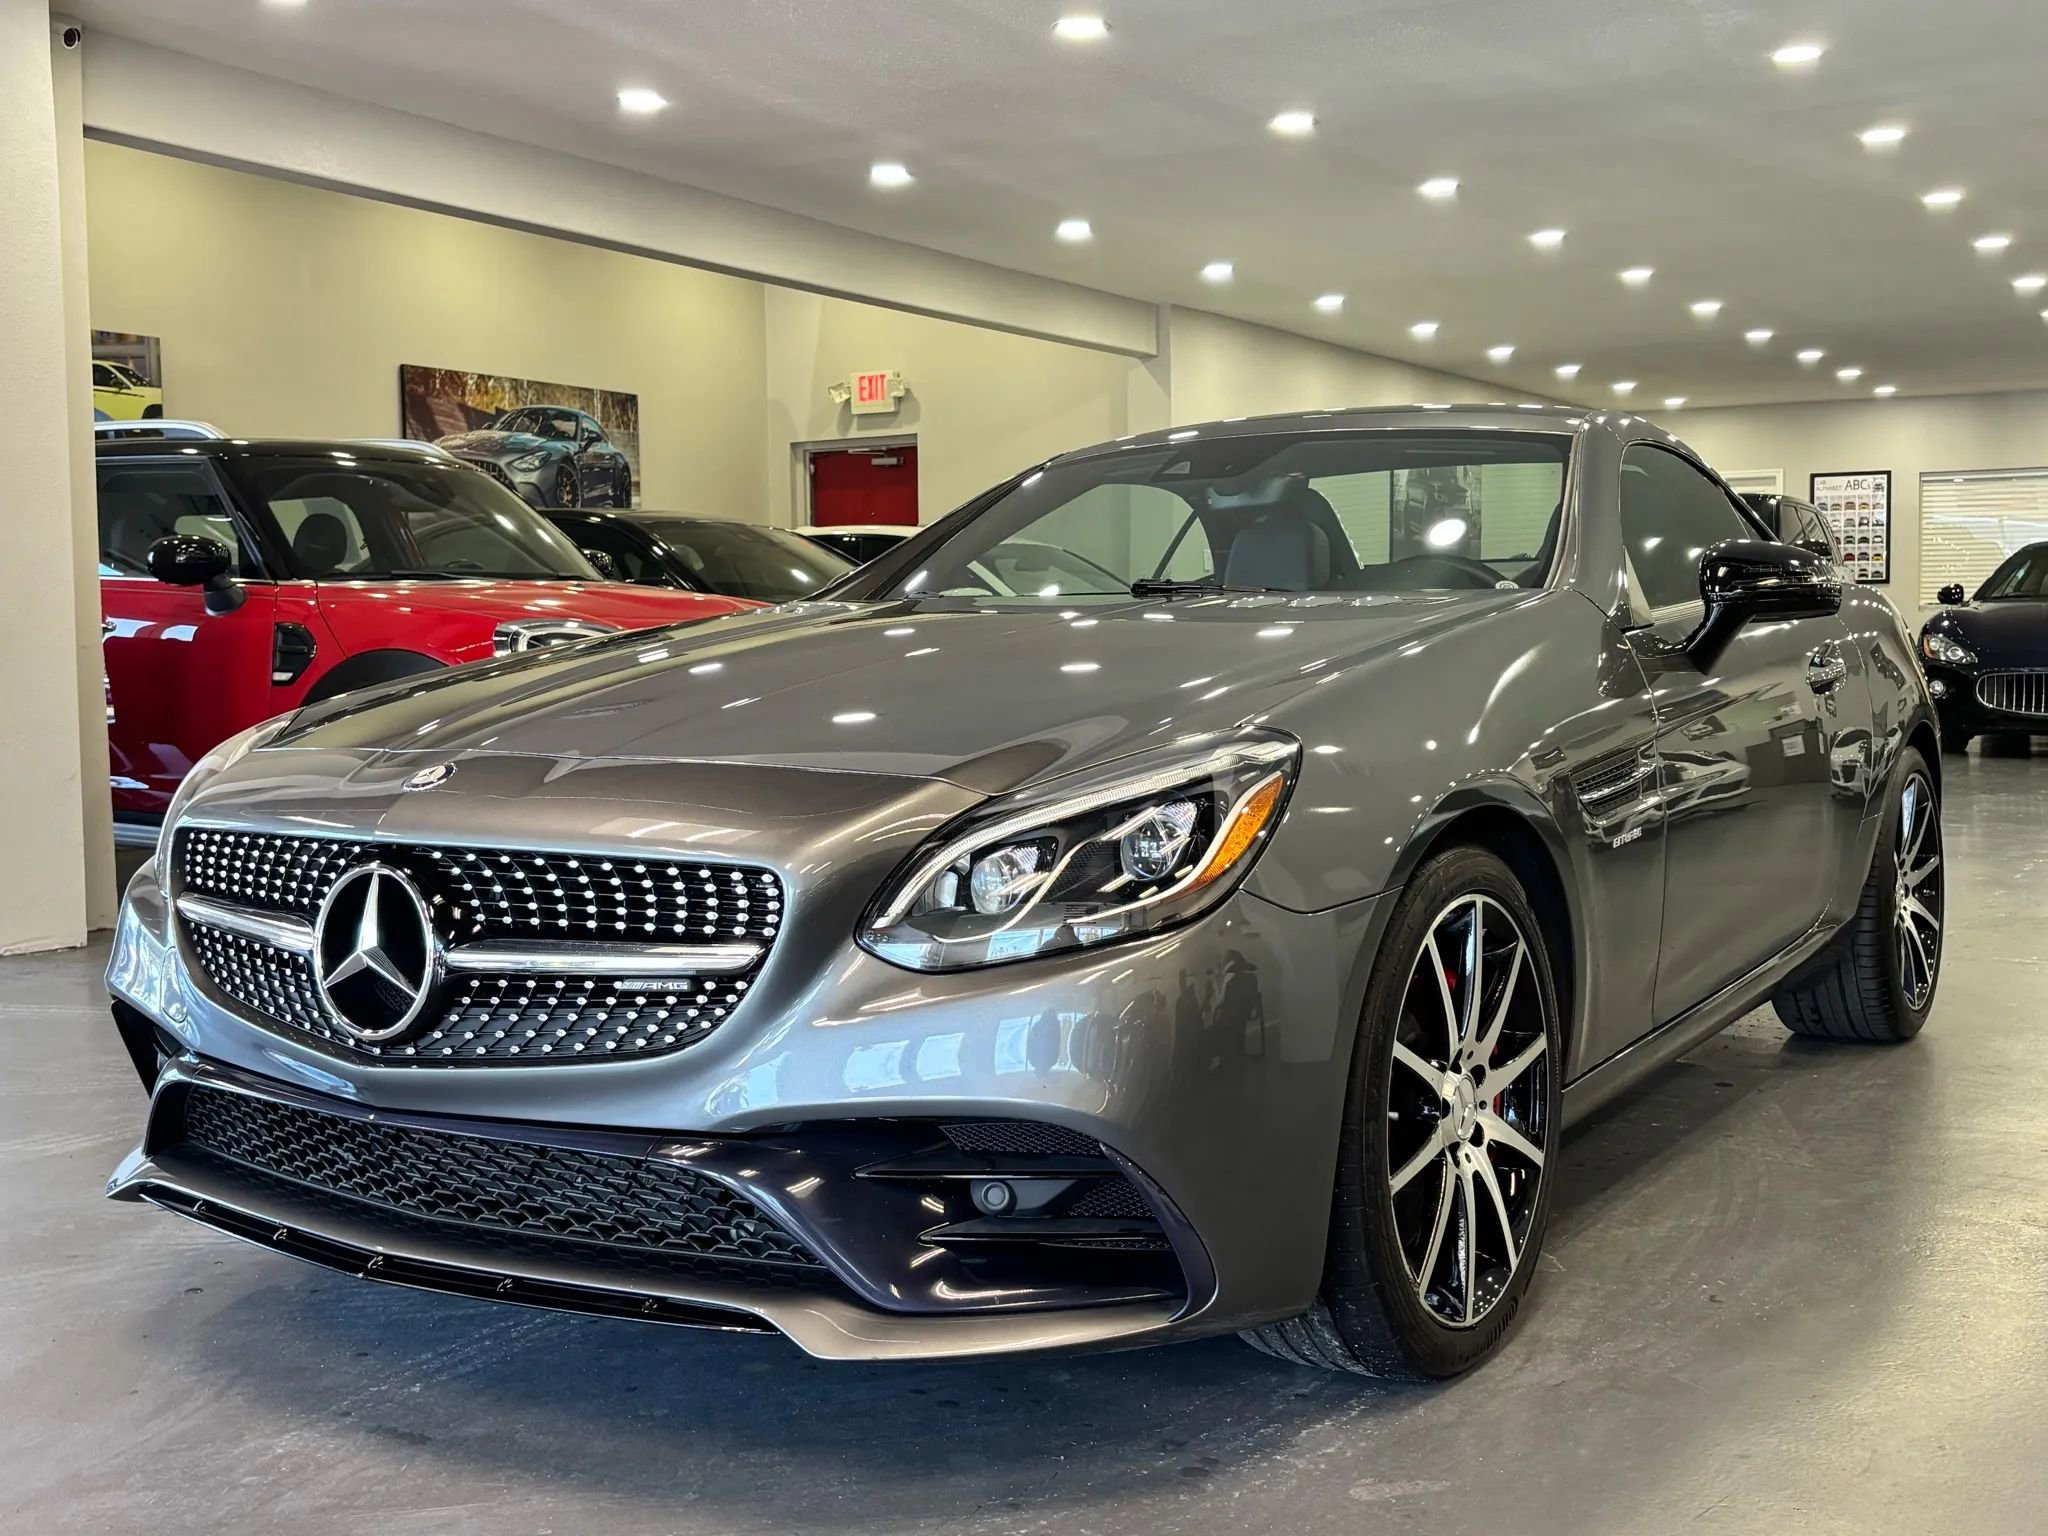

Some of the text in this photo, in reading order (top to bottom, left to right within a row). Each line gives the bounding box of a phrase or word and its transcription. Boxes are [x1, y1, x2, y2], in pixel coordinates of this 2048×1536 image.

[859, 374, 887, 402] EXIT
[1844, 479, 1871, 491] ABCs
[642, 981, 688, 990] AMG
